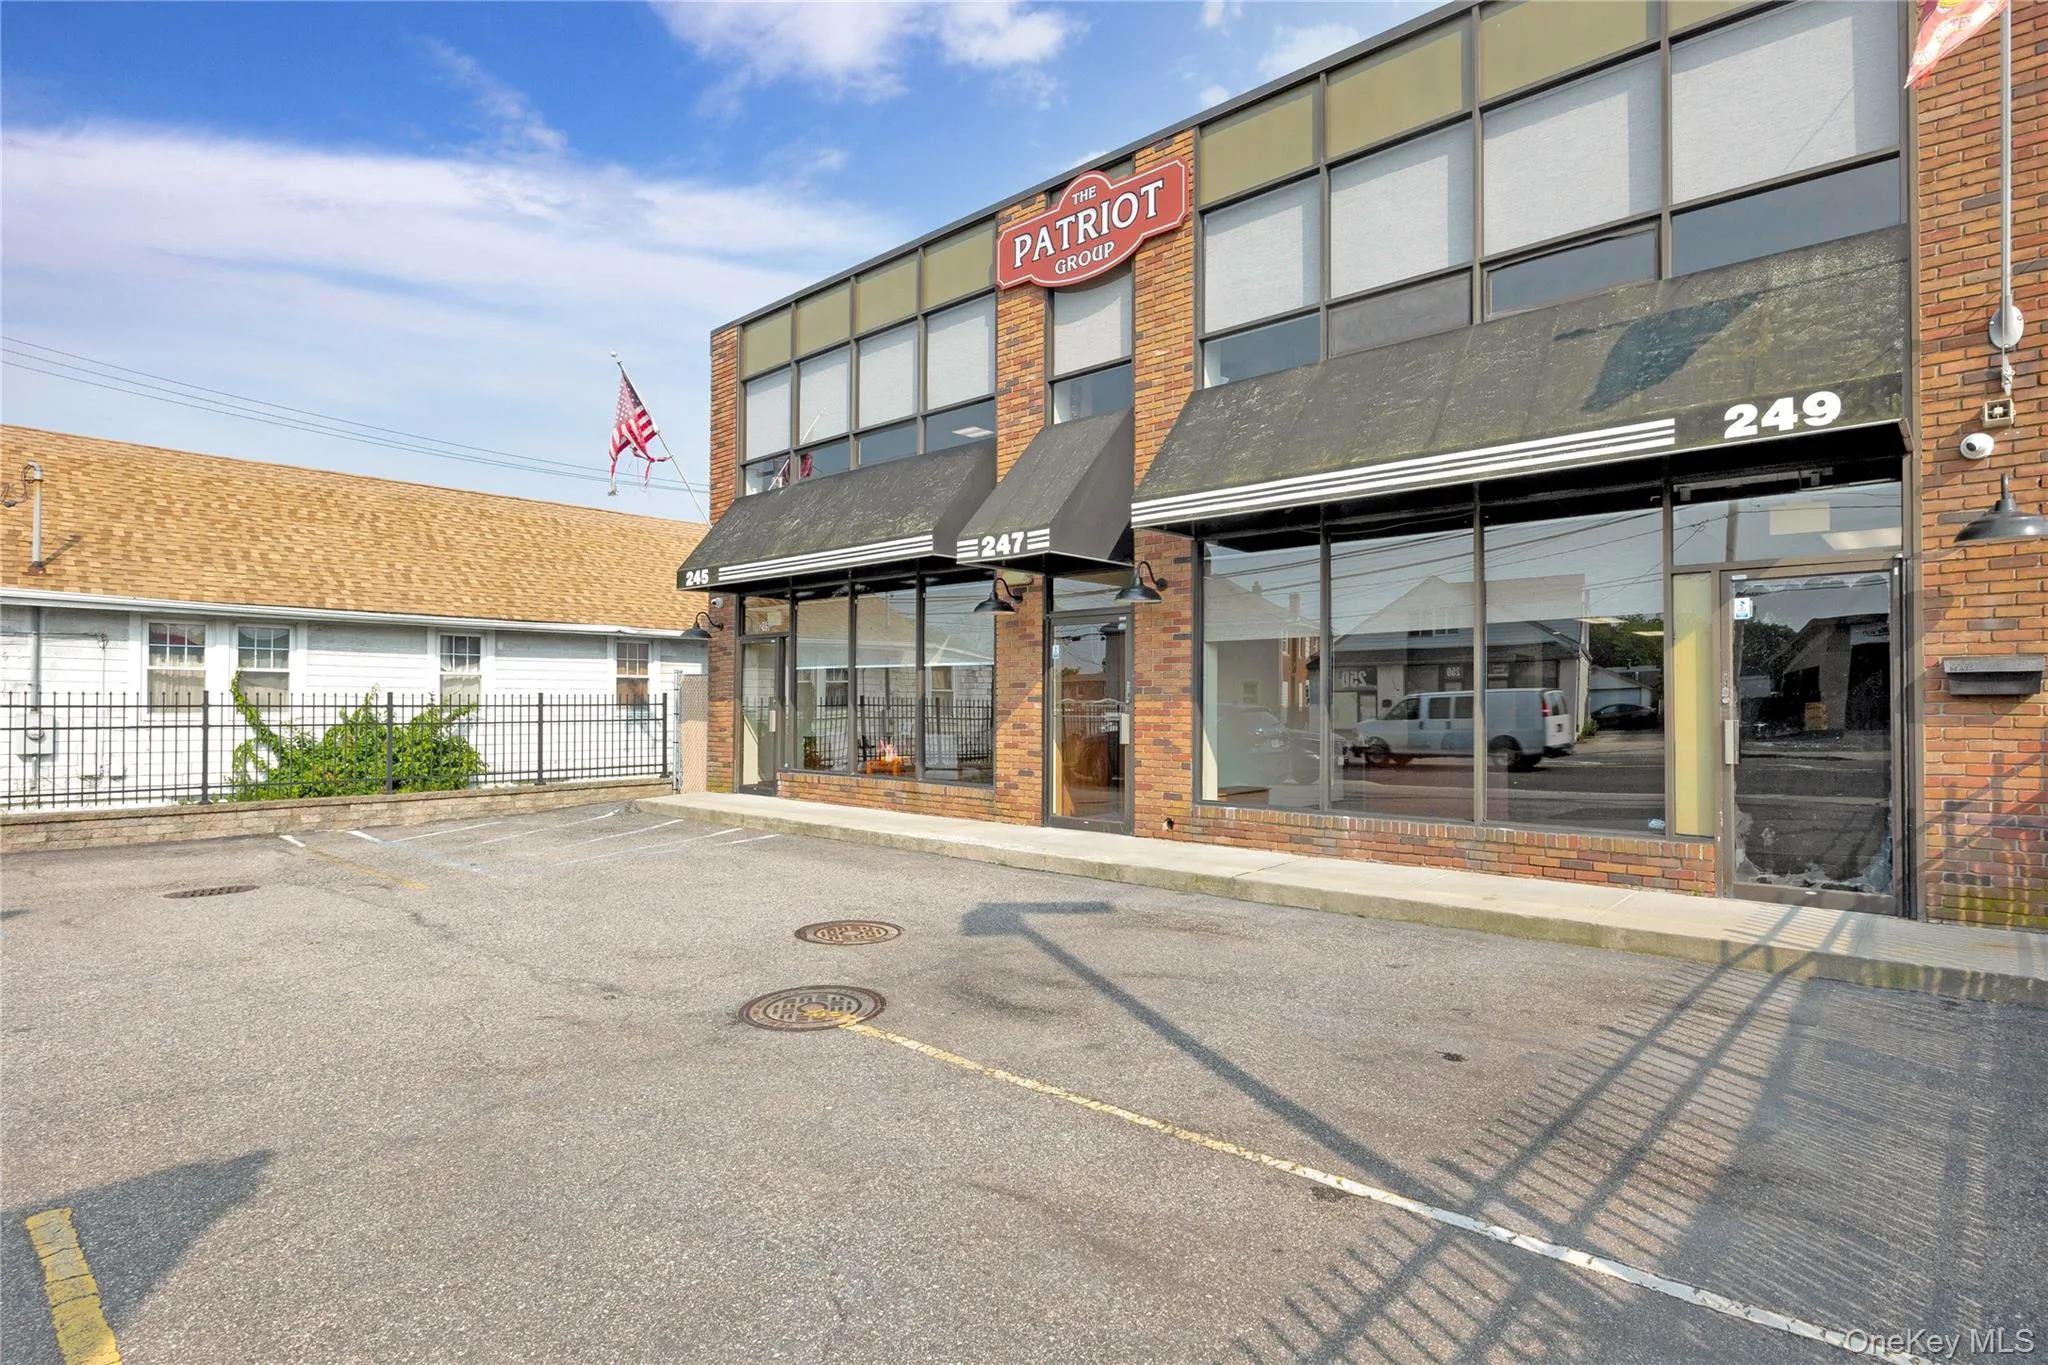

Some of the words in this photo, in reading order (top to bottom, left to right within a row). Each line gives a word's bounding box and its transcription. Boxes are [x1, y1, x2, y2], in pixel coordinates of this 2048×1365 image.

[1072, 185, 1097, 205] THE
[1013, 178, 1164, 269] PATRIOT
[1055, 241, 1115, 275] GROUP
[1724, 391, 1842, 439] 249
[981, 531, 1025, 557] 247
[685, 568, 709, 587] 245
